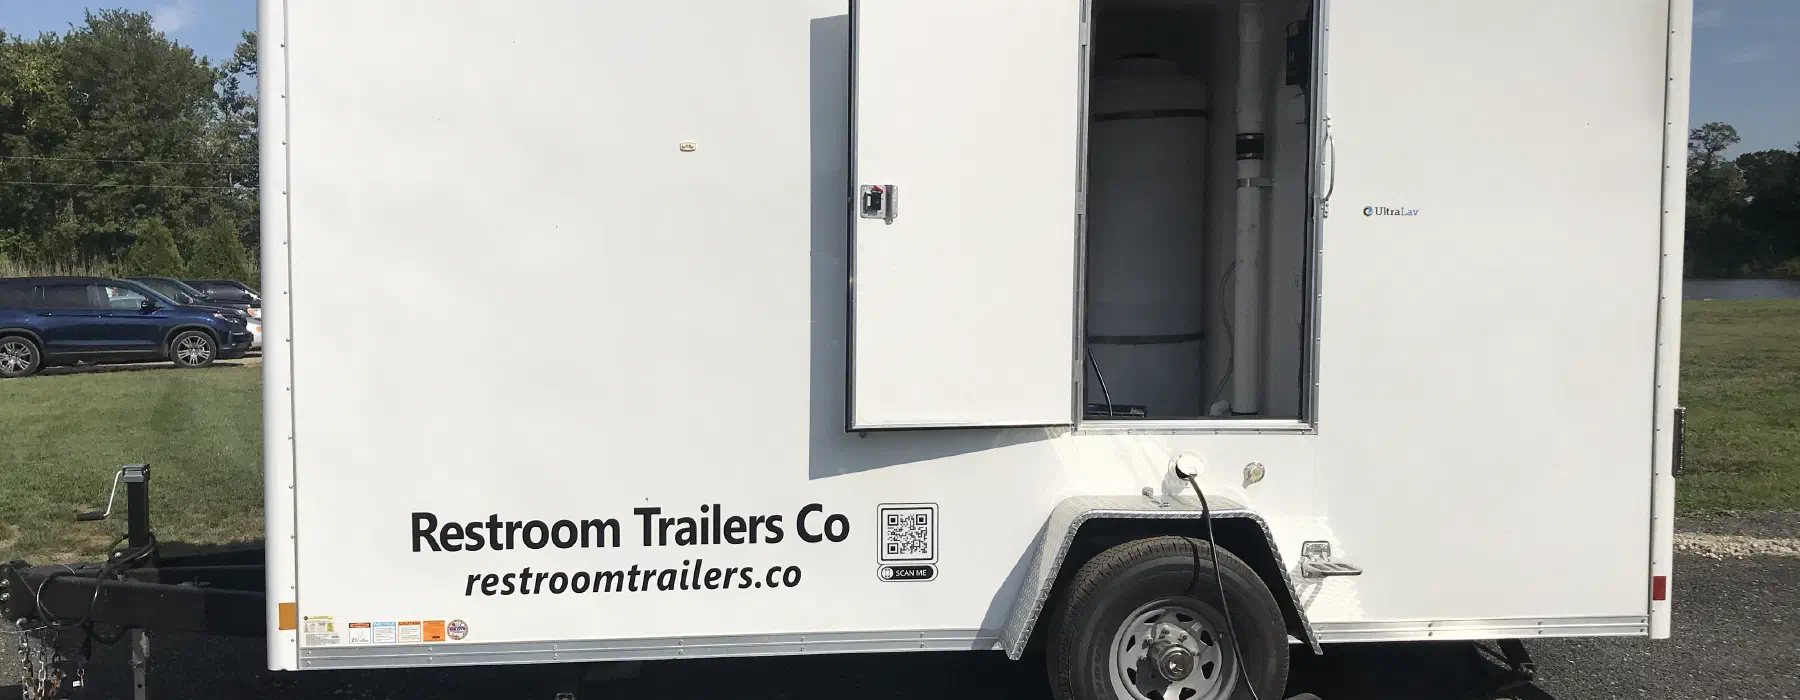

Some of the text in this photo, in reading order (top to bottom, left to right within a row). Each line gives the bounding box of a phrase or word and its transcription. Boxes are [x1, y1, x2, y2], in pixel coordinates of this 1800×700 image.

[1375, 206, 1419, 216] UltraLav
[411, 503, 850, 552] Restroom Trailers Co
[465, 558, 802, 596] restroomtrailers.co
[916, 569, 927, 577] ME
